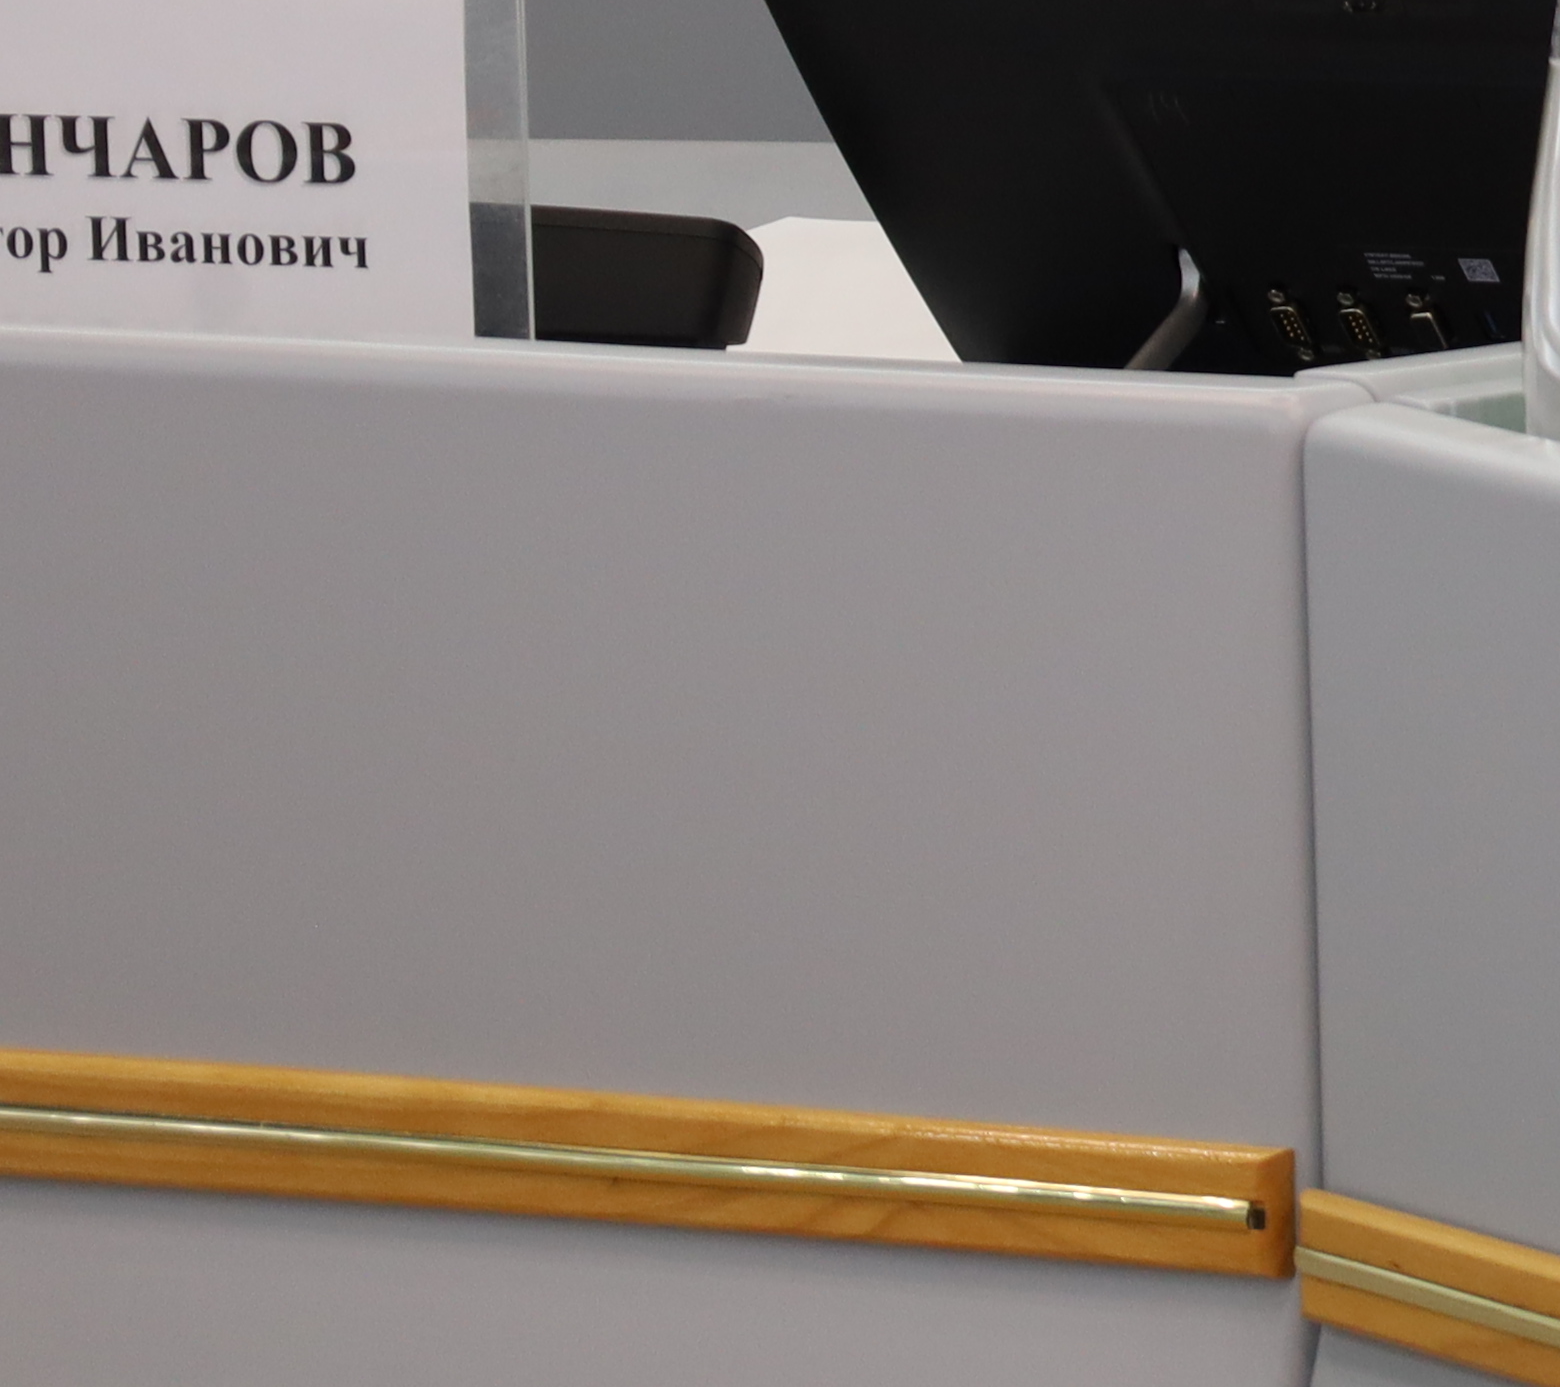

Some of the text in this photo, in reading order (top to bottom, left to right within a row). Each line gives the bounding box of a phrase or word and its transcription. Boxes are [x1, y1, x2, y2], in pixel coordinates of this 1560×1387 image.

[0, 113, 356, 186] НЧАРОВ
[0, 216, 370, 274] ор Иванович
